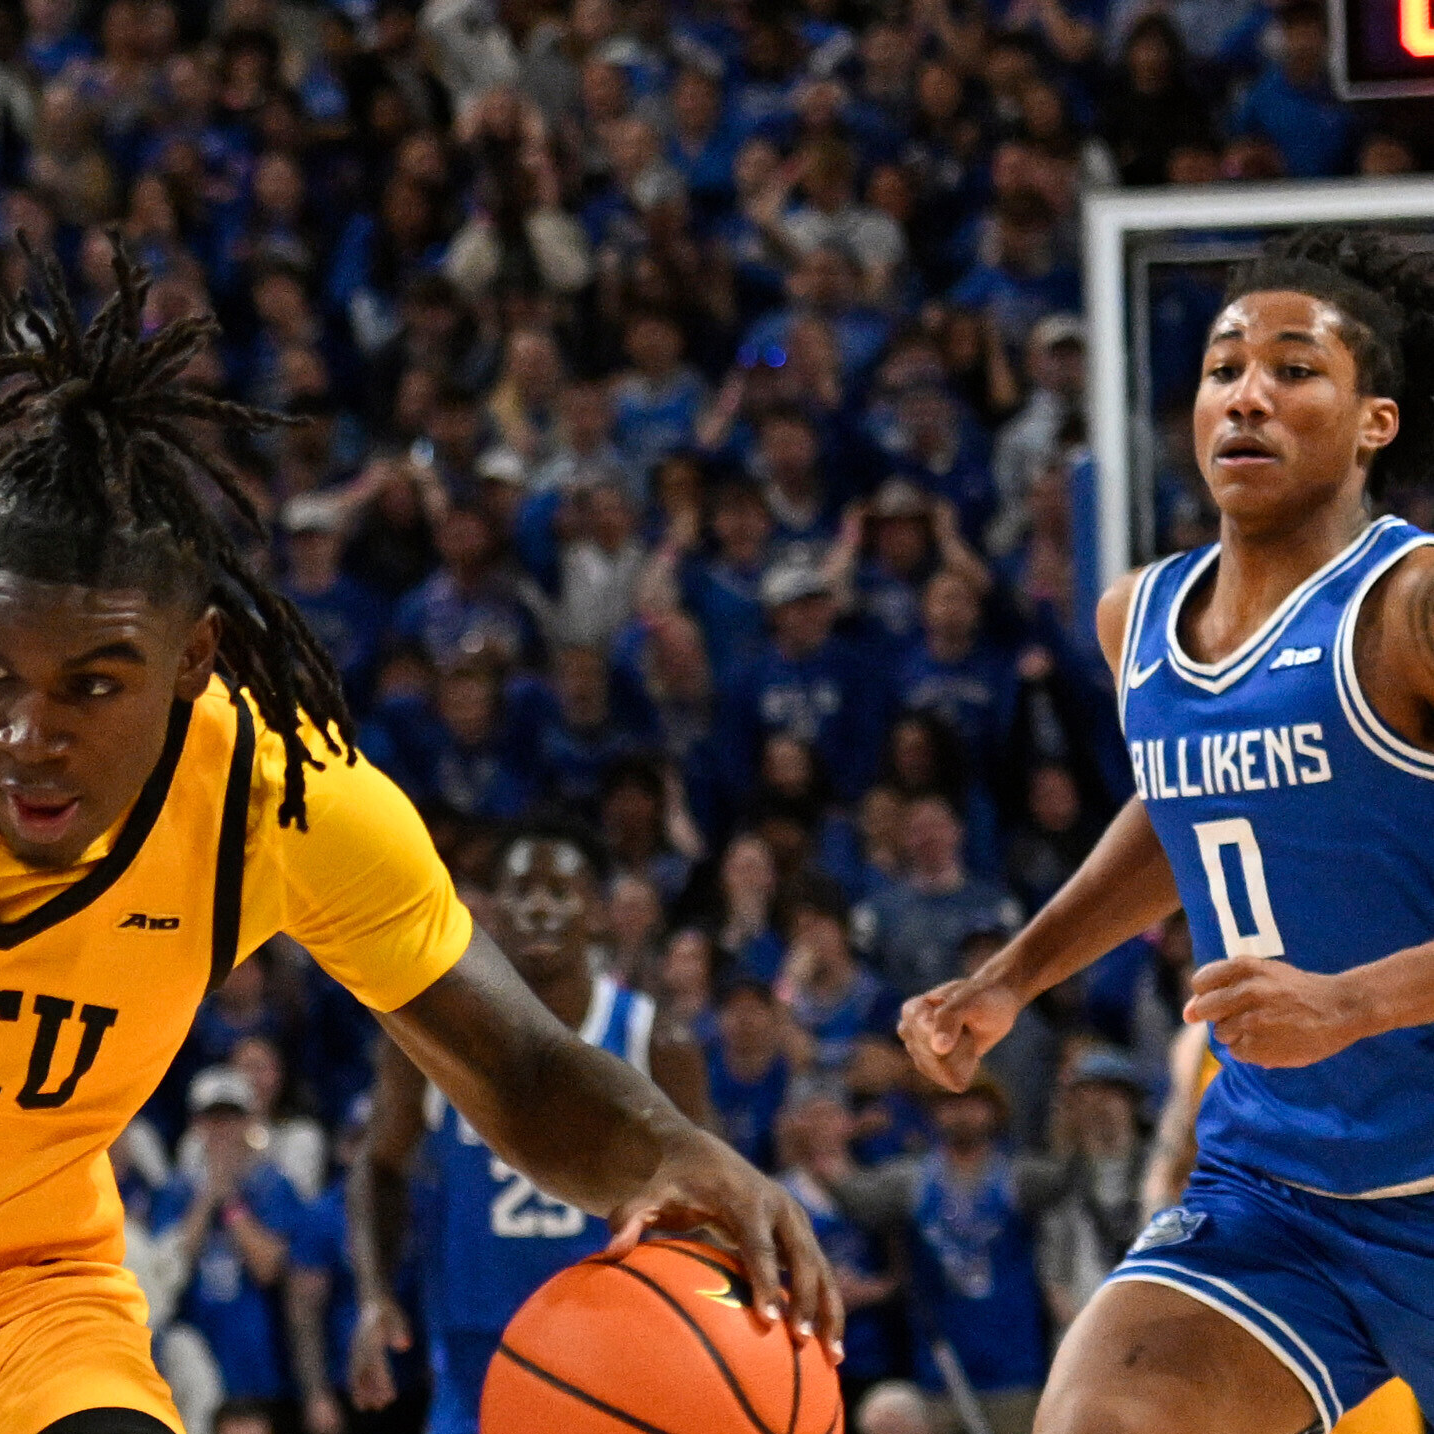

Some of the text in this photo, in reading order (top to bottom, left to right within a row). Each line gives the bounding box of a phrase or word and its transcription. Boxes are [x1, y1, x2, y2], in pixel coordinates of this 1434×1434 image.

[1133, 723, 1331, 800] BILLIKENS
[118, 913, 179, 930] A10
[1193, 817, 1285, 958] 0
